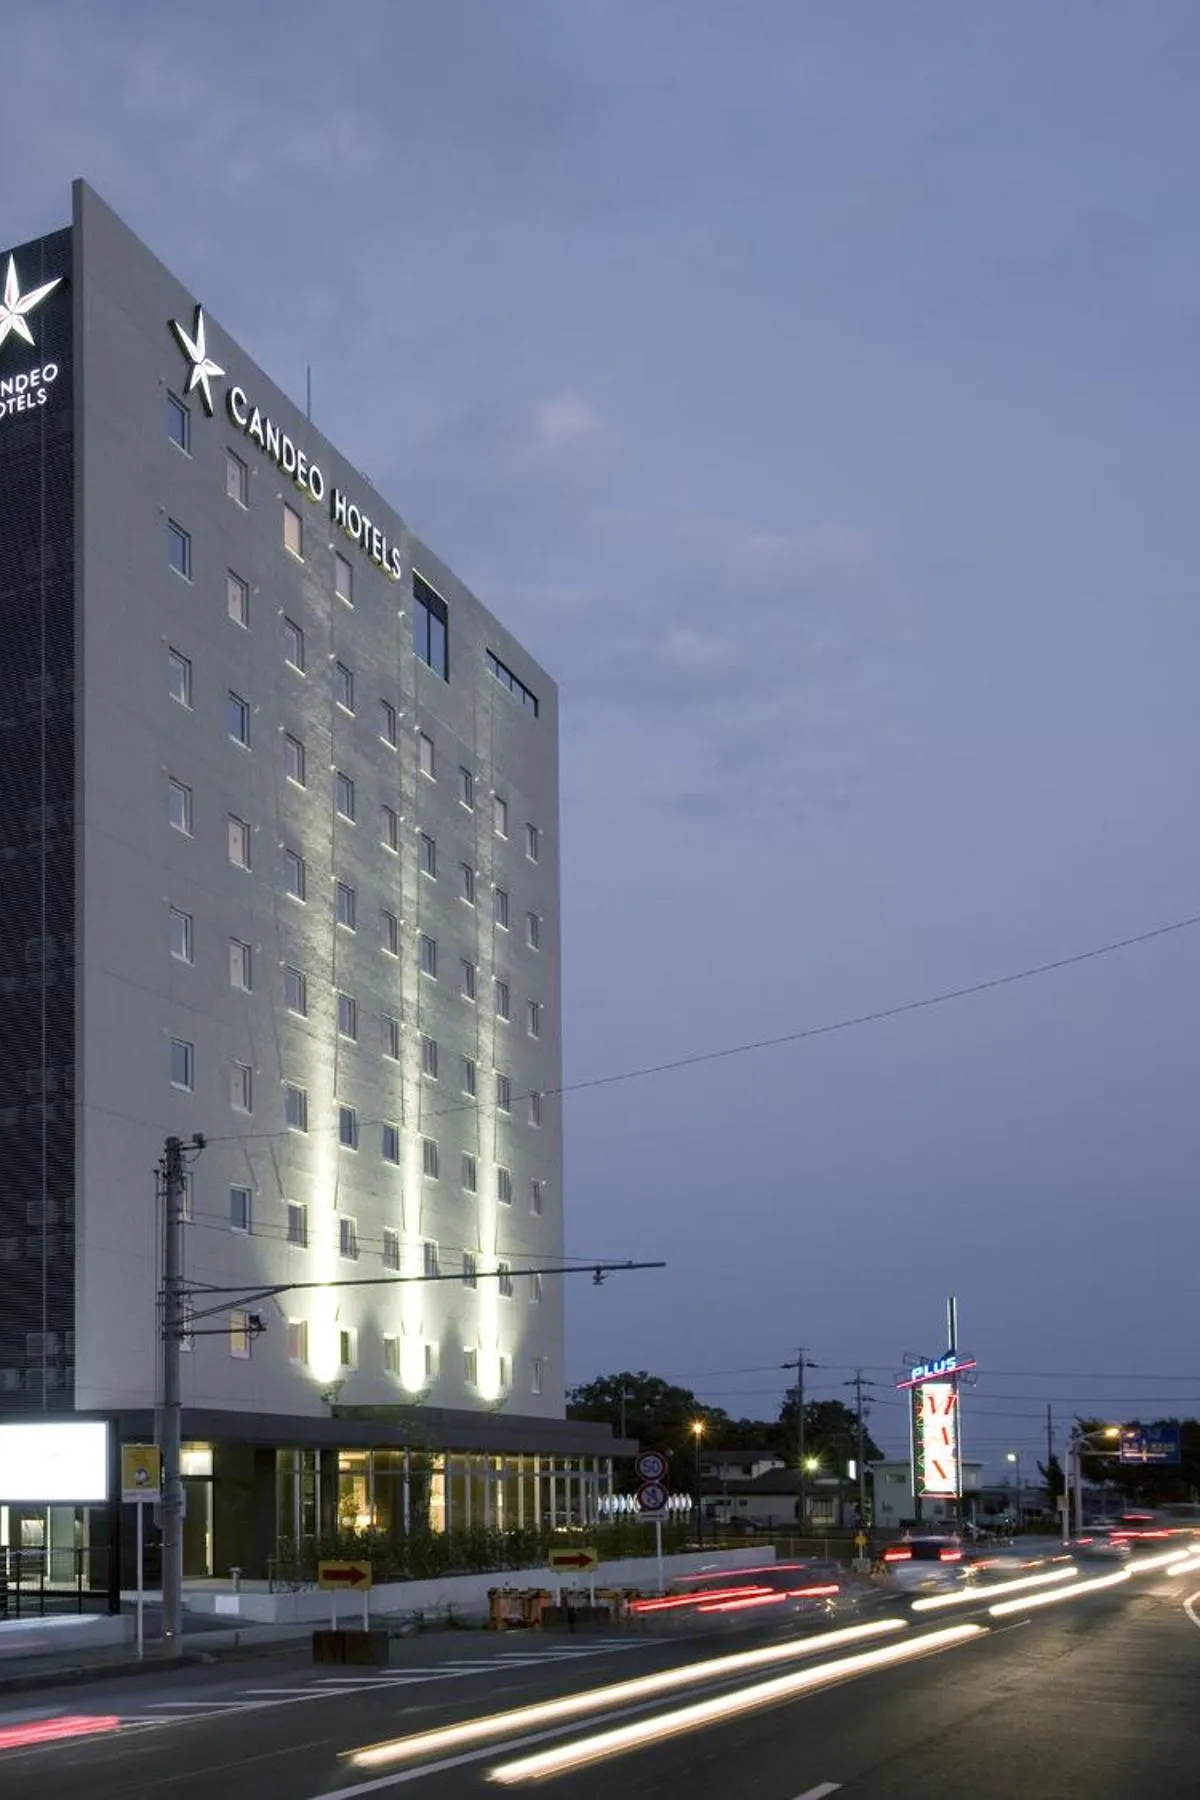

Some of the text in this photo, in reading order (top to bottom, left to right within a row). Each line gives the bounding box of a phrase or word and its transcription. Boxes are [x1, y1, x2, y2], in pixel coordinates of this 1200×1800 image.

[228, 387, 401, 580] CANDEO HOTELS
[911, 1356, 957, 1381] PLUS
[642, 1459, 661, 1473] 50
